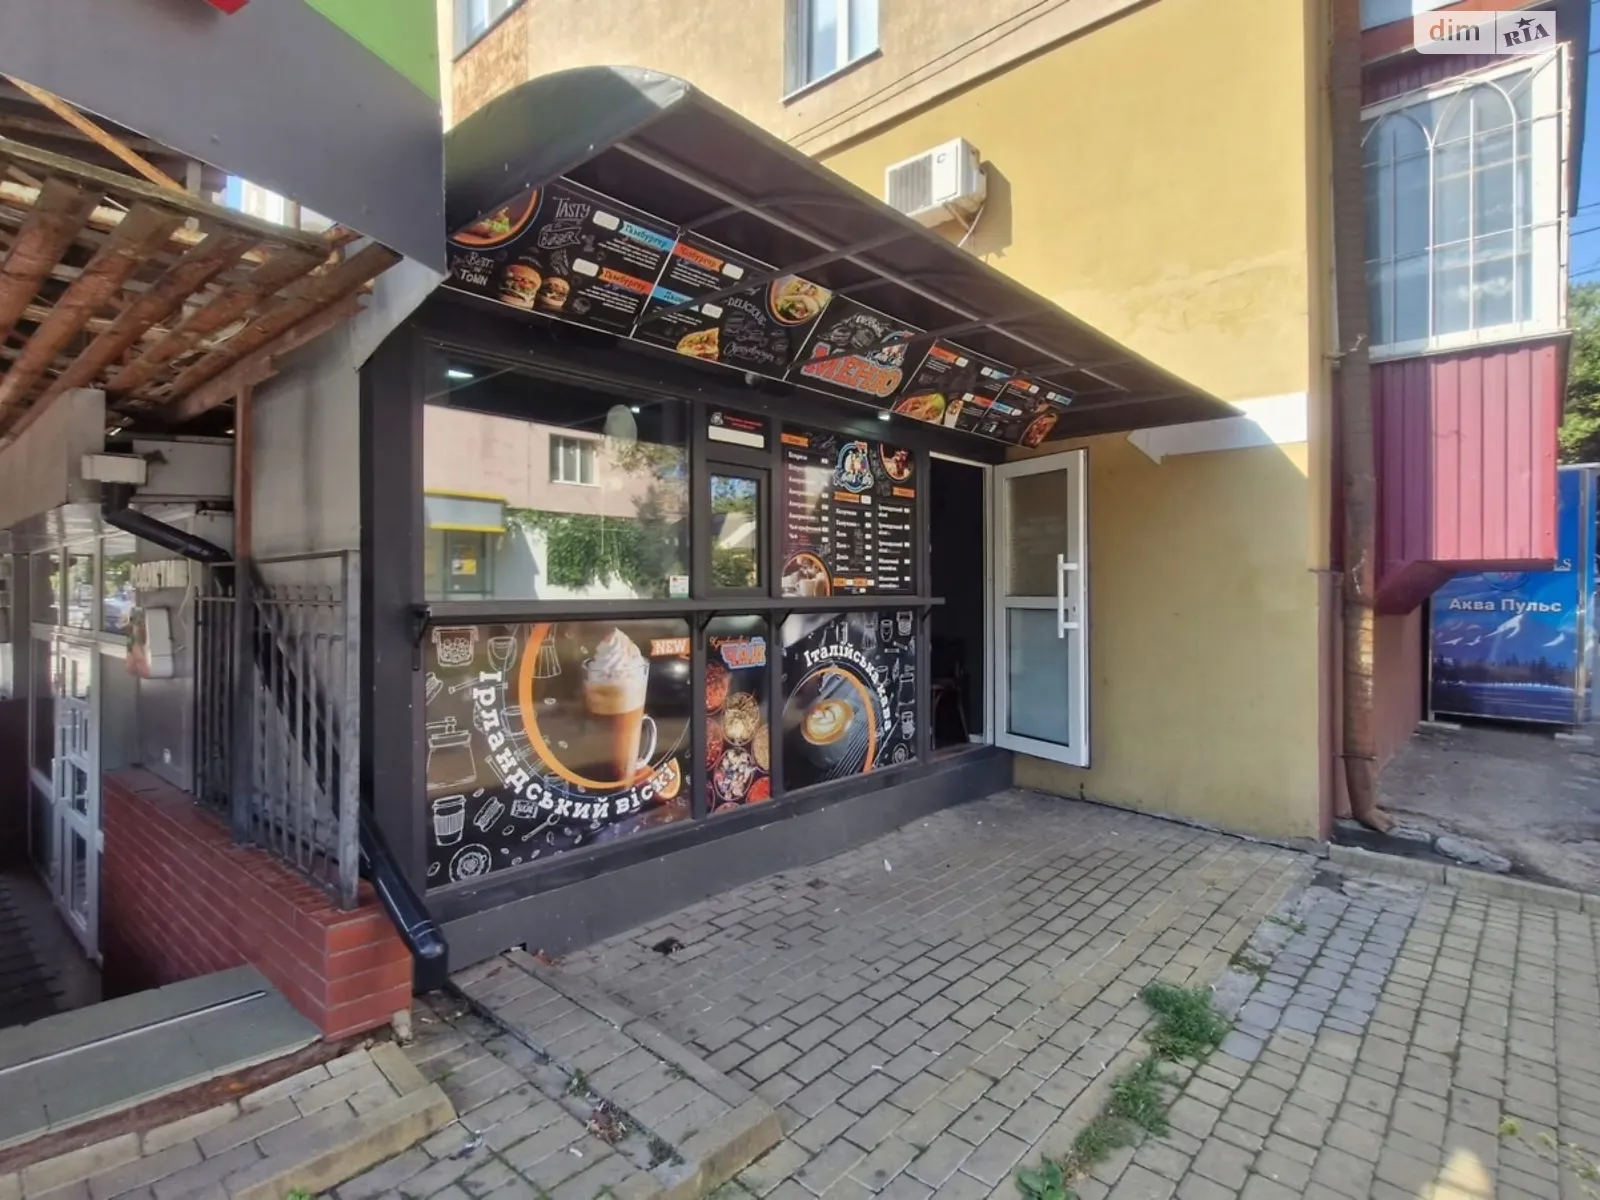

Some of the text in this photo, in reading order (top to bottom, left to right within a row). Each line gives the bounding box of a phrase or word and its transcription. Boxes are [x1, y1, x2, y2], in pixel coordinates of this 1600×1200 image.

[1449, 597, 1563, 616] Аква Пульс
[653, 640, 688, 656] NEW
[876, 685, 892, 732] кава
[472, 670, 676, 820] Ірландський віскі
